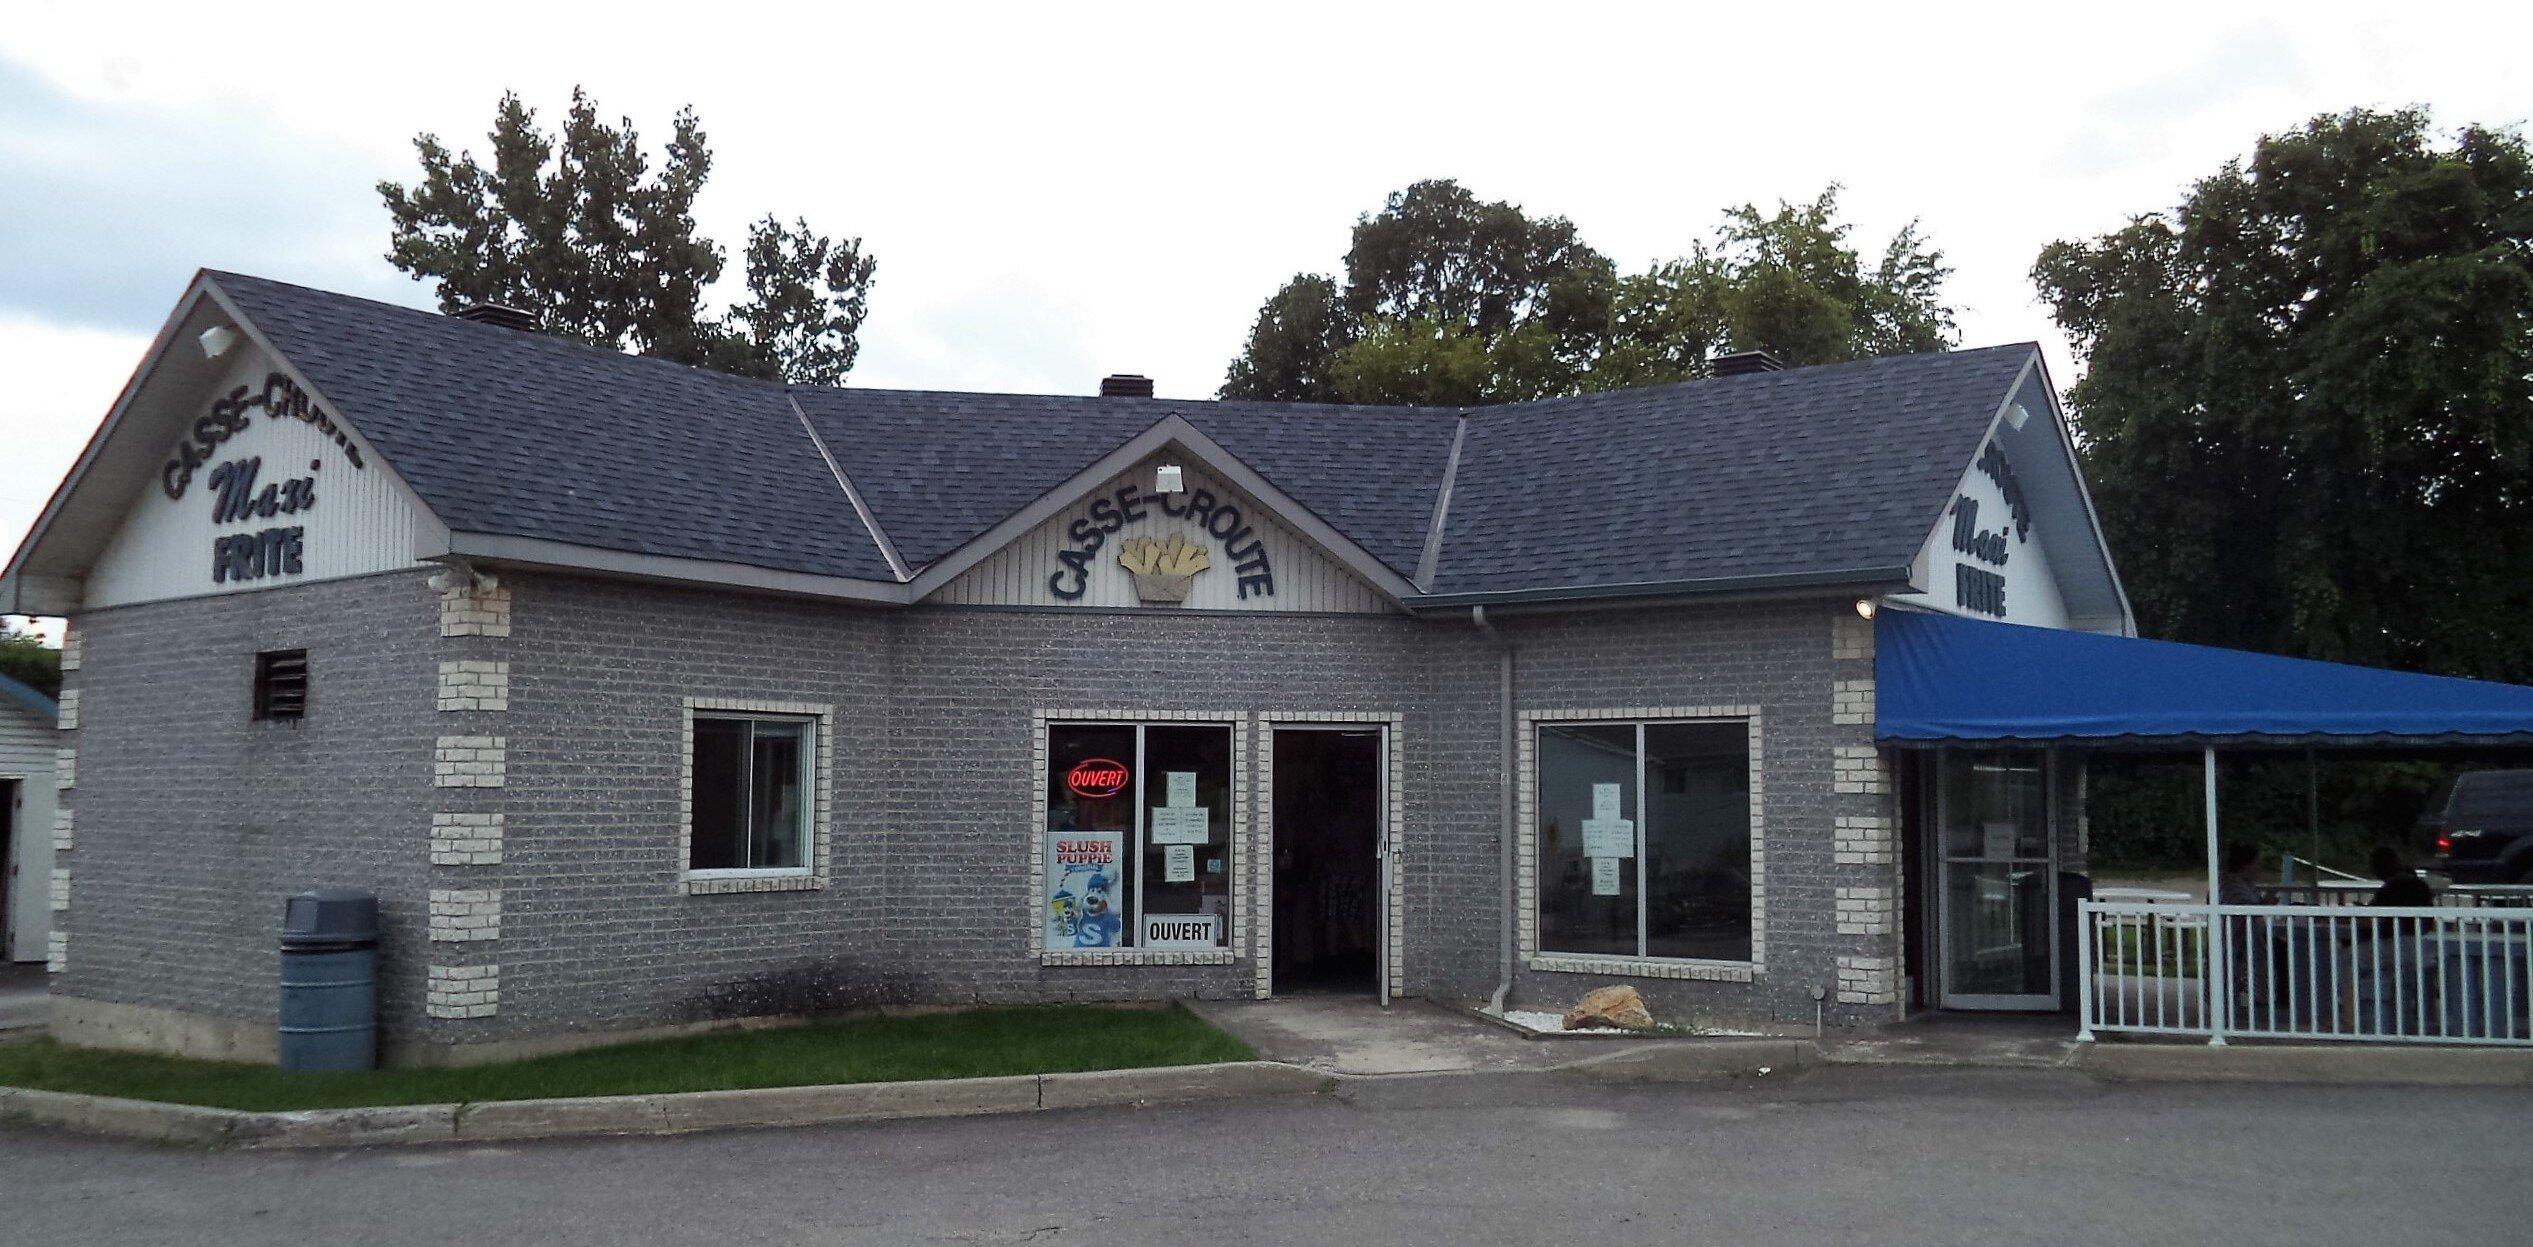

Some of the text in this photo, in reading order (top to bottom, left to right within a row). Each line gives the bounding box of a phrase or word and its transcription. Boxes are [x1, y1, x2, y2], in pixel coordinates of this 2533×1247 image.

[208, 456, 320, 524] Maxi
[1050, 485, 1275, 600] CASSE-CROUTE
[212, 526, 304, 583] FRITE
[1071, 770, 1124, 787] OUVERT
[1056, 841, 1113, 853] SLUSH
[1056, 853, 1113, 864] PUPPIE
[1150, 922, 1211, 941] OUVERT
